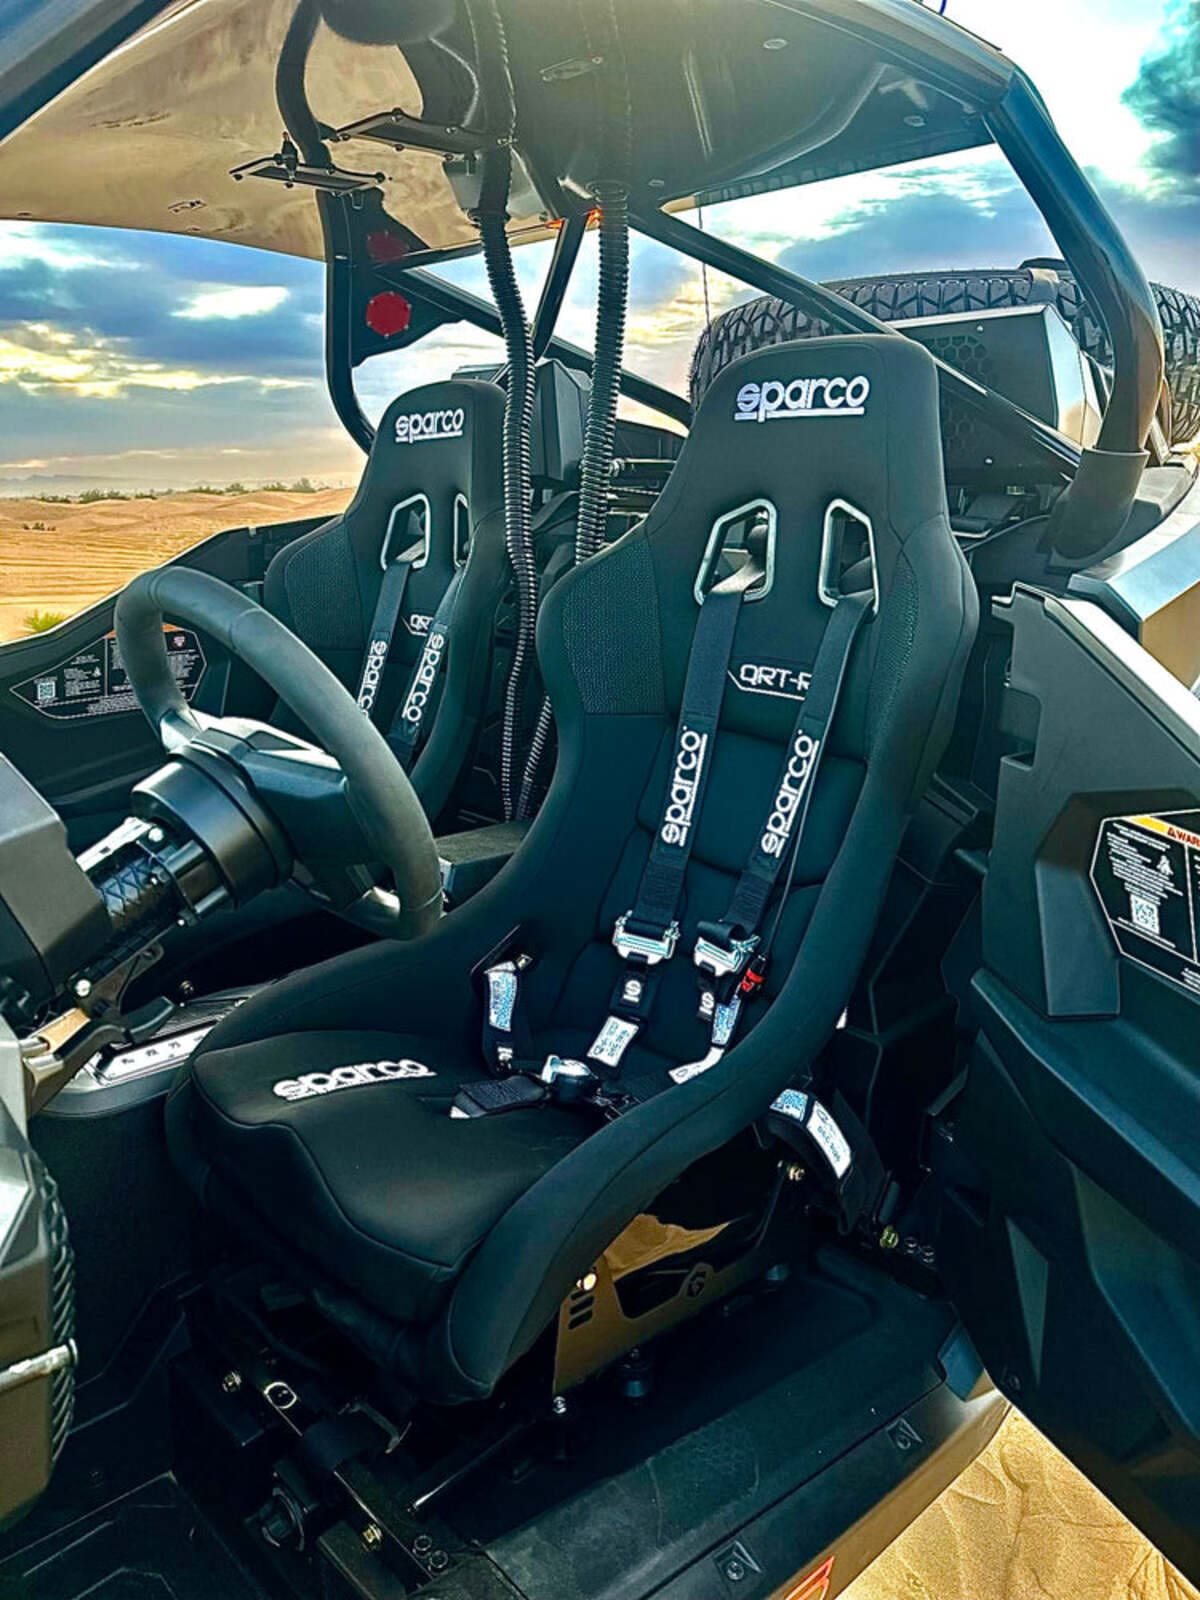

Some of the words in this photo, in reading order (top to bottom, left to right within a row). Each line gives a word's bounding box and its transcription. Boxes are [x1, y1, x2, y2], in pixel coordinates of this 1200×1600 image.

[395, 408, 465, 443] sparco
[734, 375, 870, 422] sparco
[402, 632, 444, 722] sparco
[660, 731, 708, 847] sparco
[761, 735, 820, 859] sparco
[272, 1059, 437, 1102] sparco
